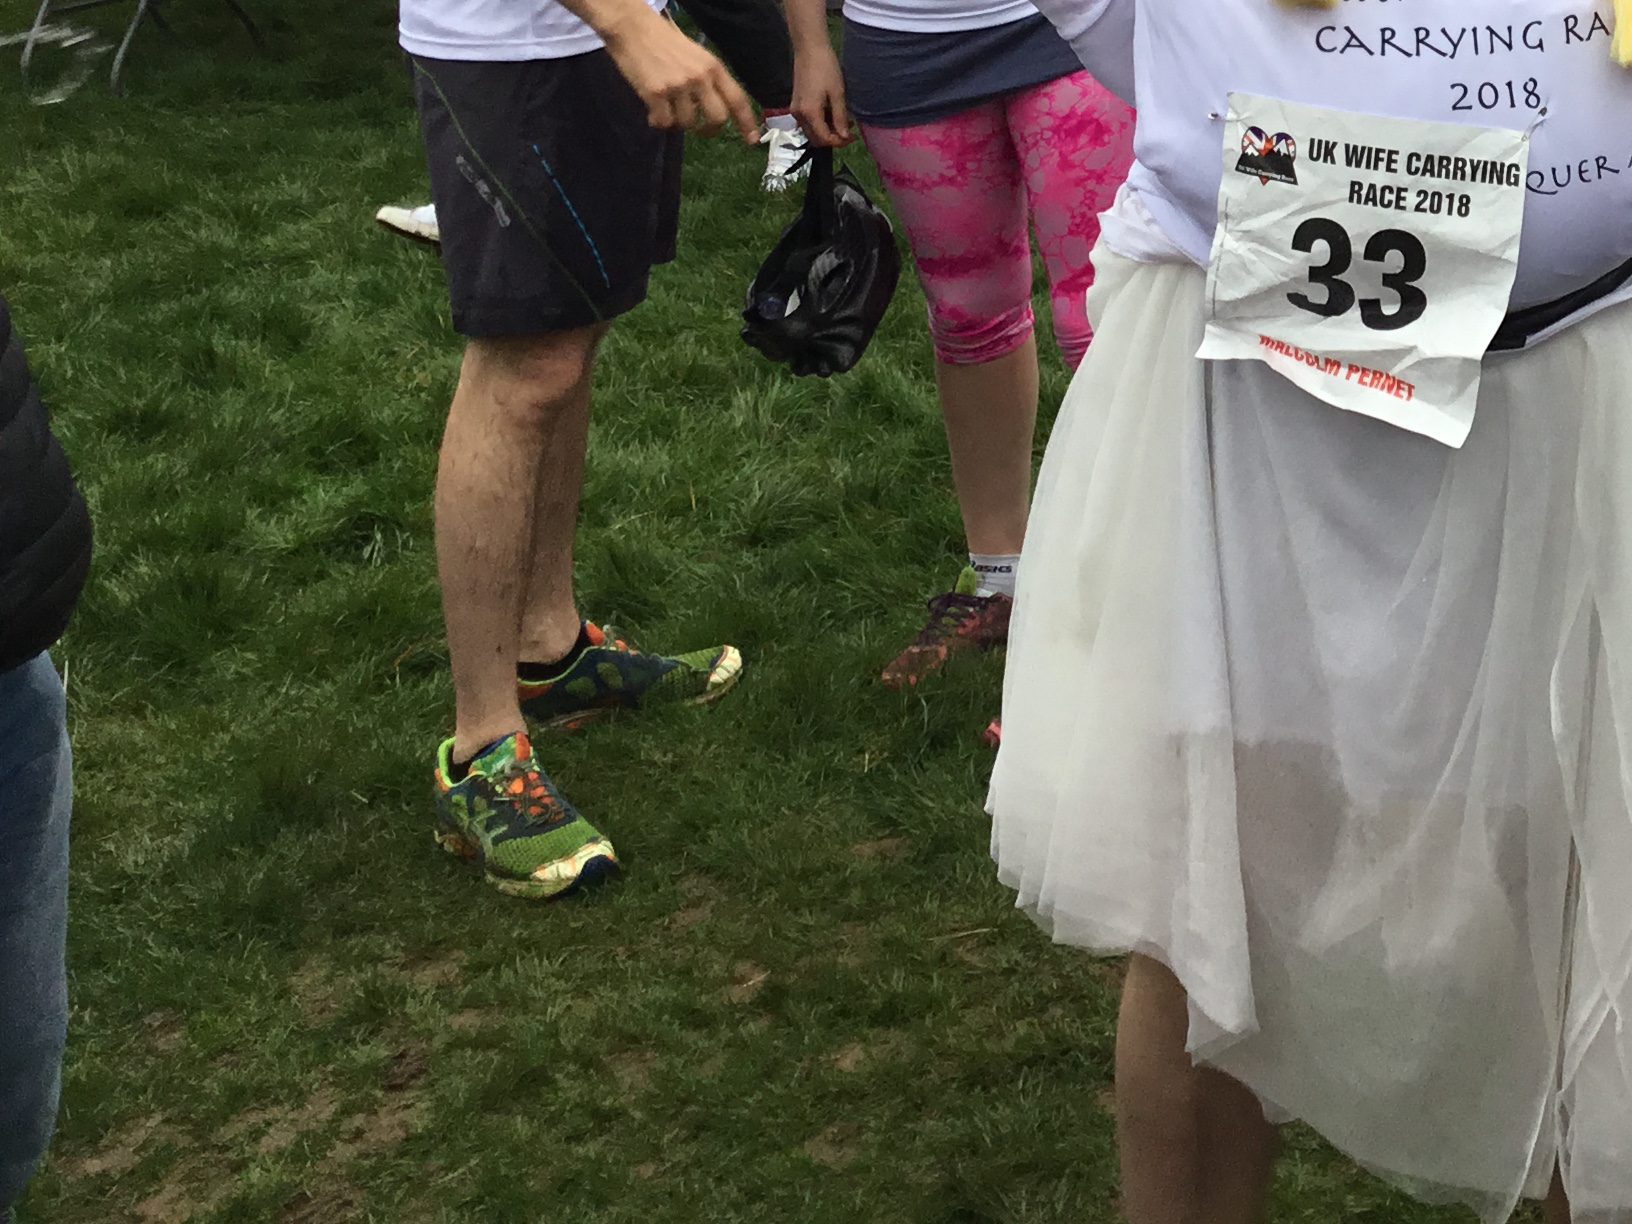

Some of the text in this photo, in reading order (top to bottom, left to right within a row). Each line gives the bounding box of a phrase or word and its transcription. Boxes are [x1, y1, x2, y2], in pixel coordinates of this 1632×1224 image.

[1315, 20, 1545, 59] CARRYING
[1450, 77, 1542, 111] 2018
[1308, 137, 1521, 187] UK WIFE CARRYING
[1348, 180, 1472, 218] RACE 2018
[1286, 217, 1428, 331] 33
[1258, 333, 1416, 402] MALCOLM PERNET
